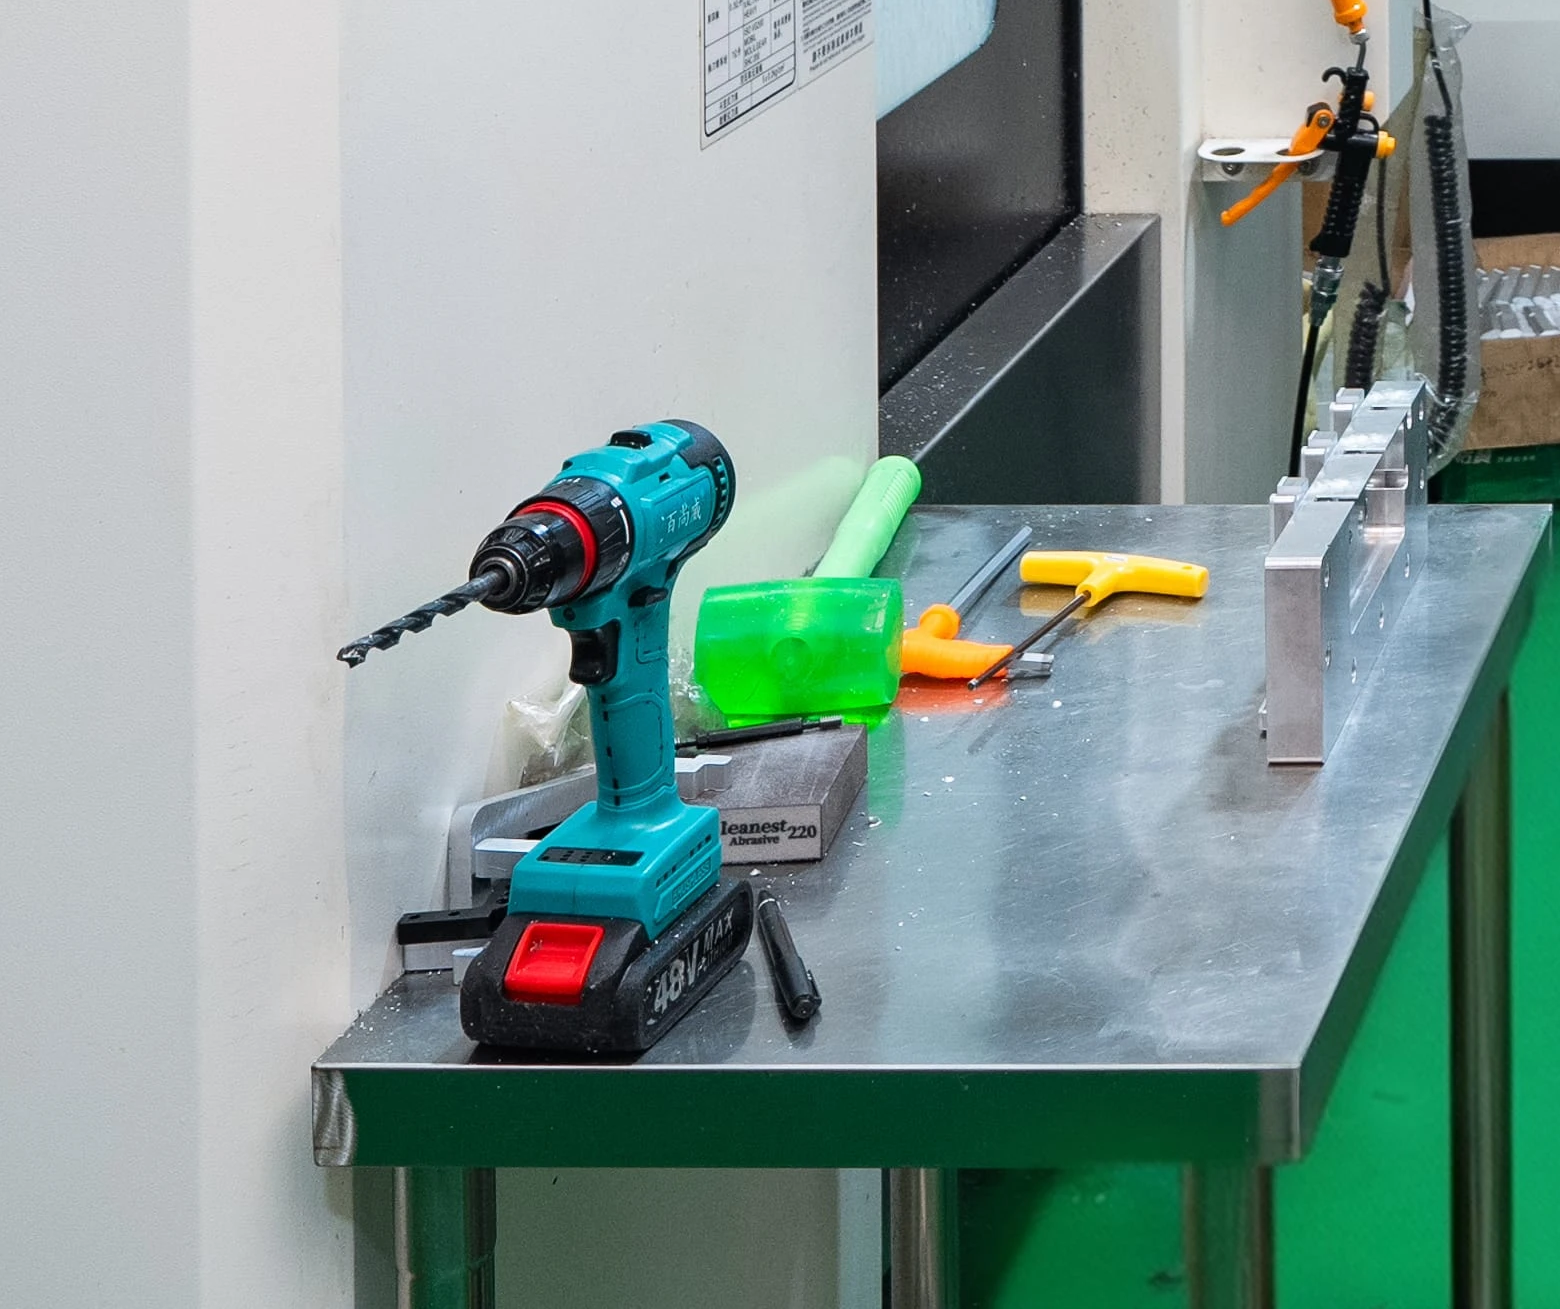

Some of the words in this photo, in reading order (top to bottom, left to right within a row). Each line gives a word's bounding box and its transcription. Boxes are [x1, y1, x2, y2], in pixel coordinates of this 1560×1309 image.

[721, 820, 787, 835] leanest
[787, 825, 816, 839] 220
[729, 836, 779, 846] Abrasive
[672, 859, 711, 901] BRUSHLESS
[654, 940, 699, 1015] 48V
[703, 908, 734, 952] MAX
